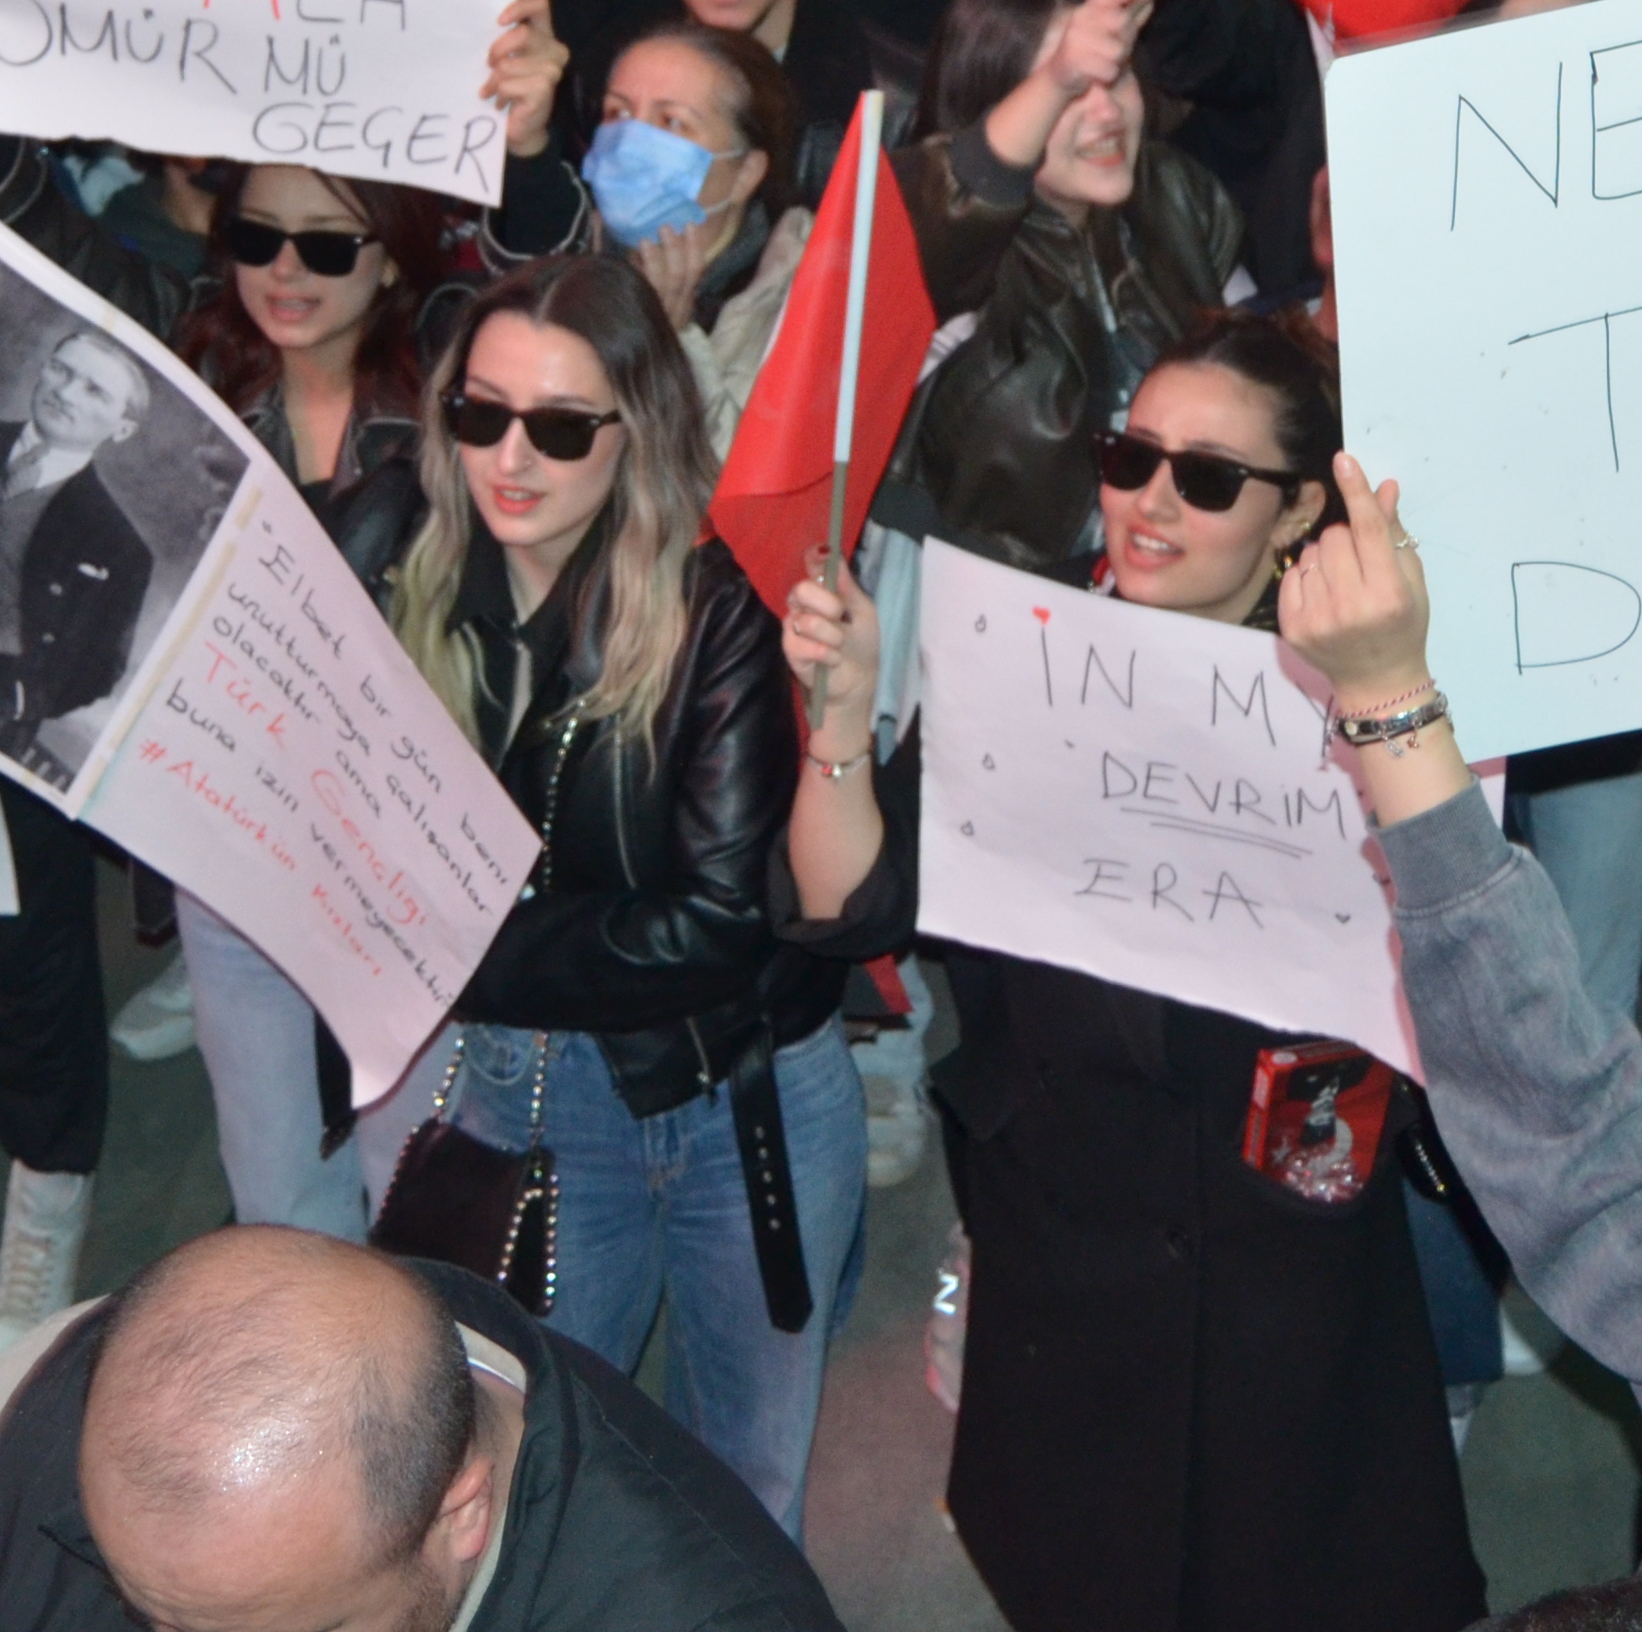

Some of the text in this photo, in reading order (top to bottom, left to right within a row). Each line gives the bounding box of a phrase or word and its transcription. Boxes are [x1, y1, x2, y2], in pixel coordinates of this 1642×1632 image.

[263, 33, 347, 98] MÜ
[165, 677, 238, 755] buna
[255, 764, 300, 815] izin
[205, 642, 289, 756] Türk
[360, 673, 392, 720] bir
[391, 732, 443, 795] gün
[335, 749, 383, 821] ama
[1073, 856, 1265, 930] ERA
